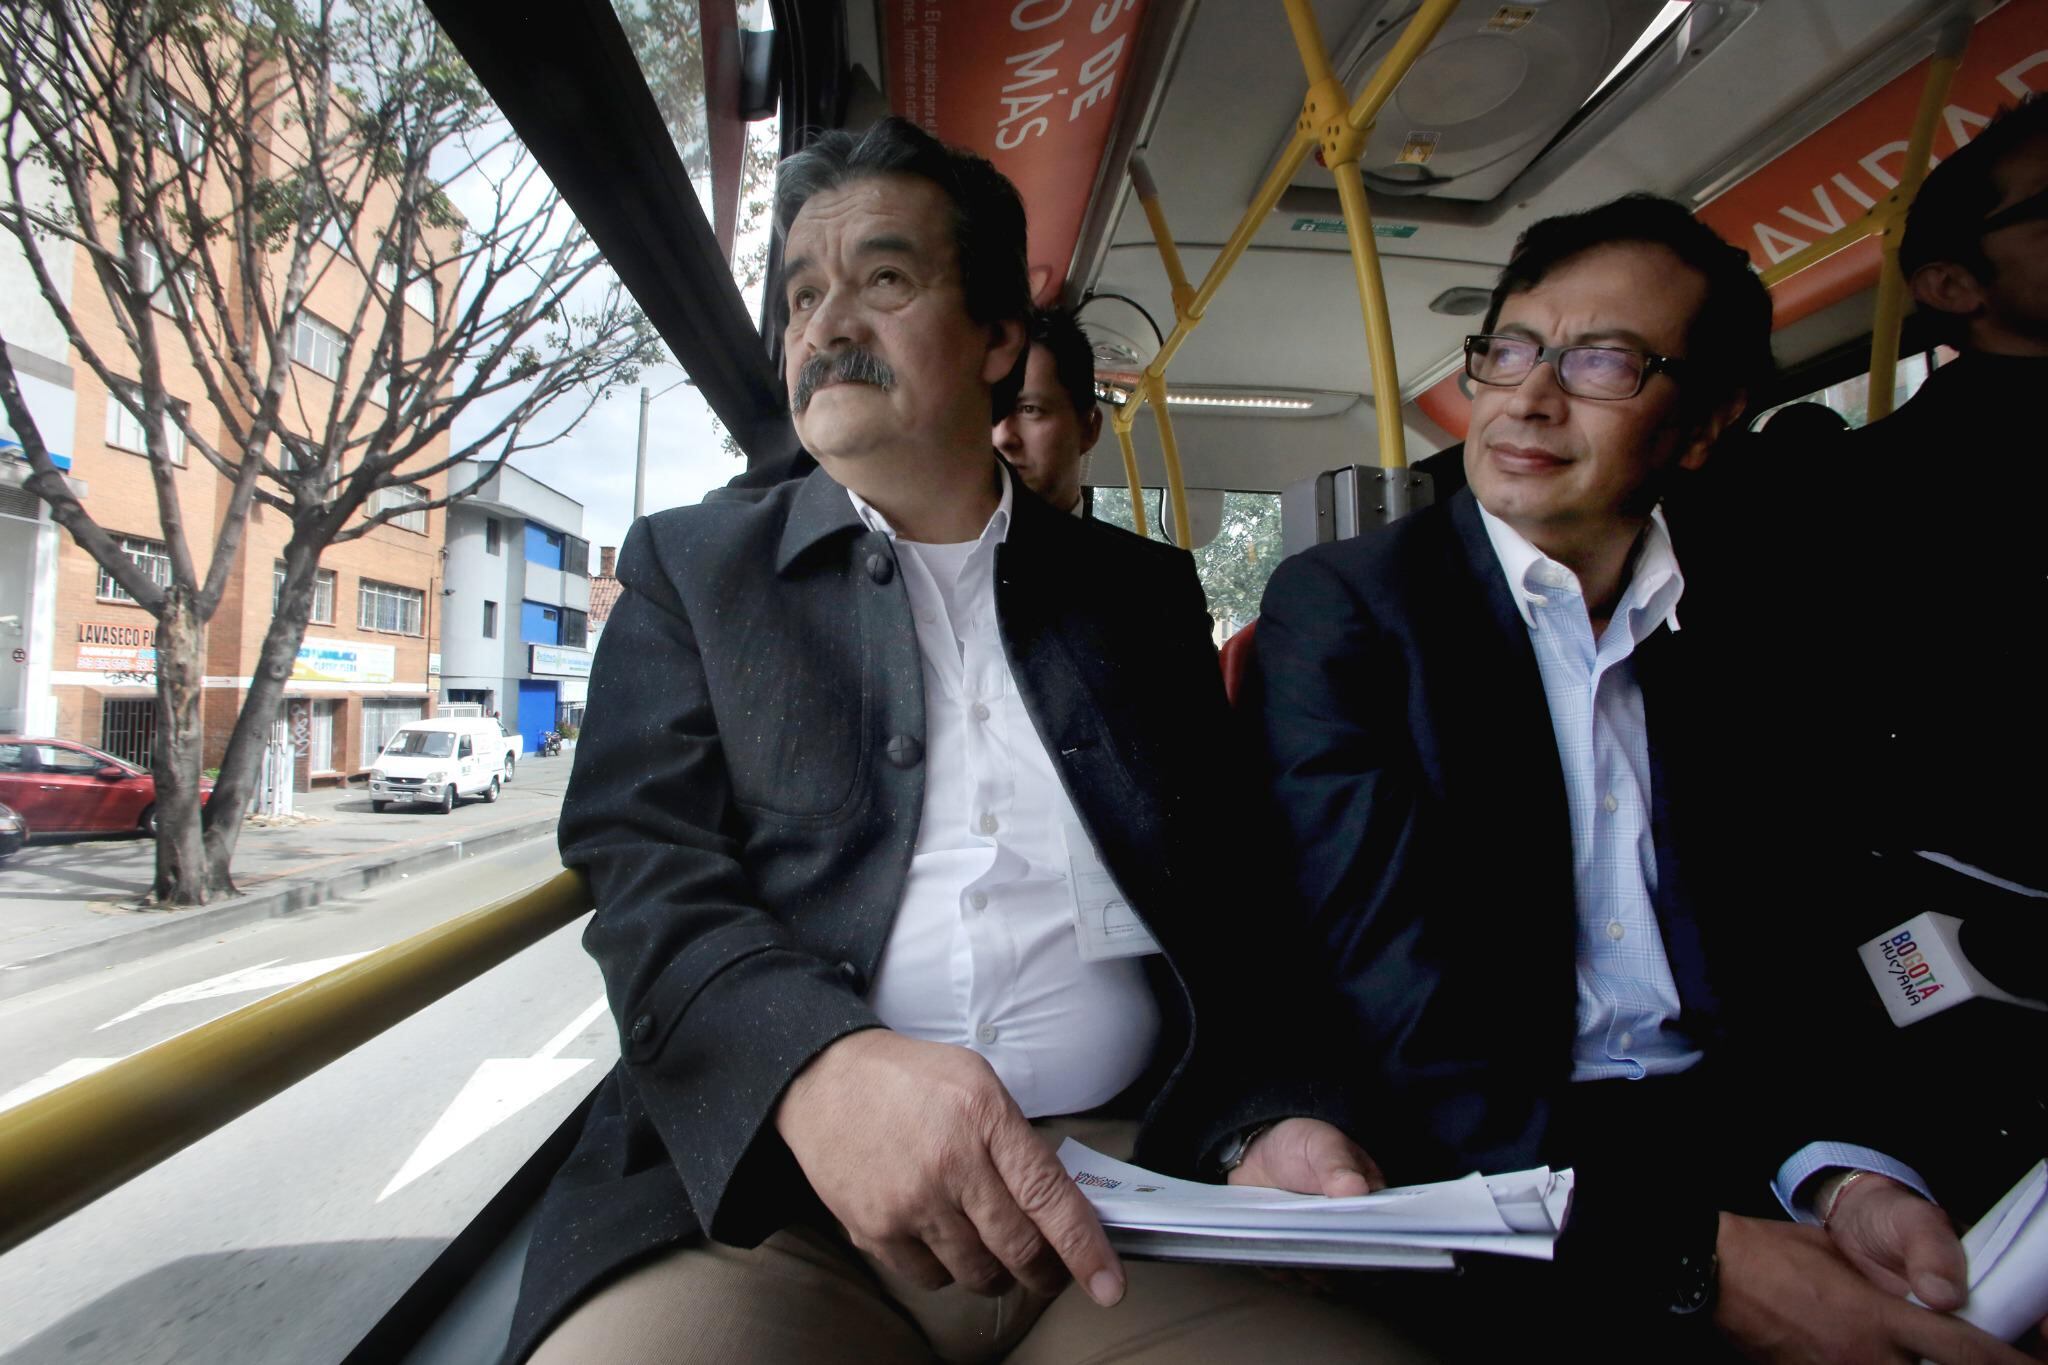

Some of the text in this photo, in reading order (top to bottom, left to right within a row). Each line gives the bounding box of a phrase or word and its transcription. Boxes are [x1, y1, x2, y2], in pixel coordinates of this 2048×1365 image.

[995, 39, 1068, 149] MÁS
[79, 624, 140, 647] LAVASECO
[1890, 931, 1944, 1000] BOGOTÁ
